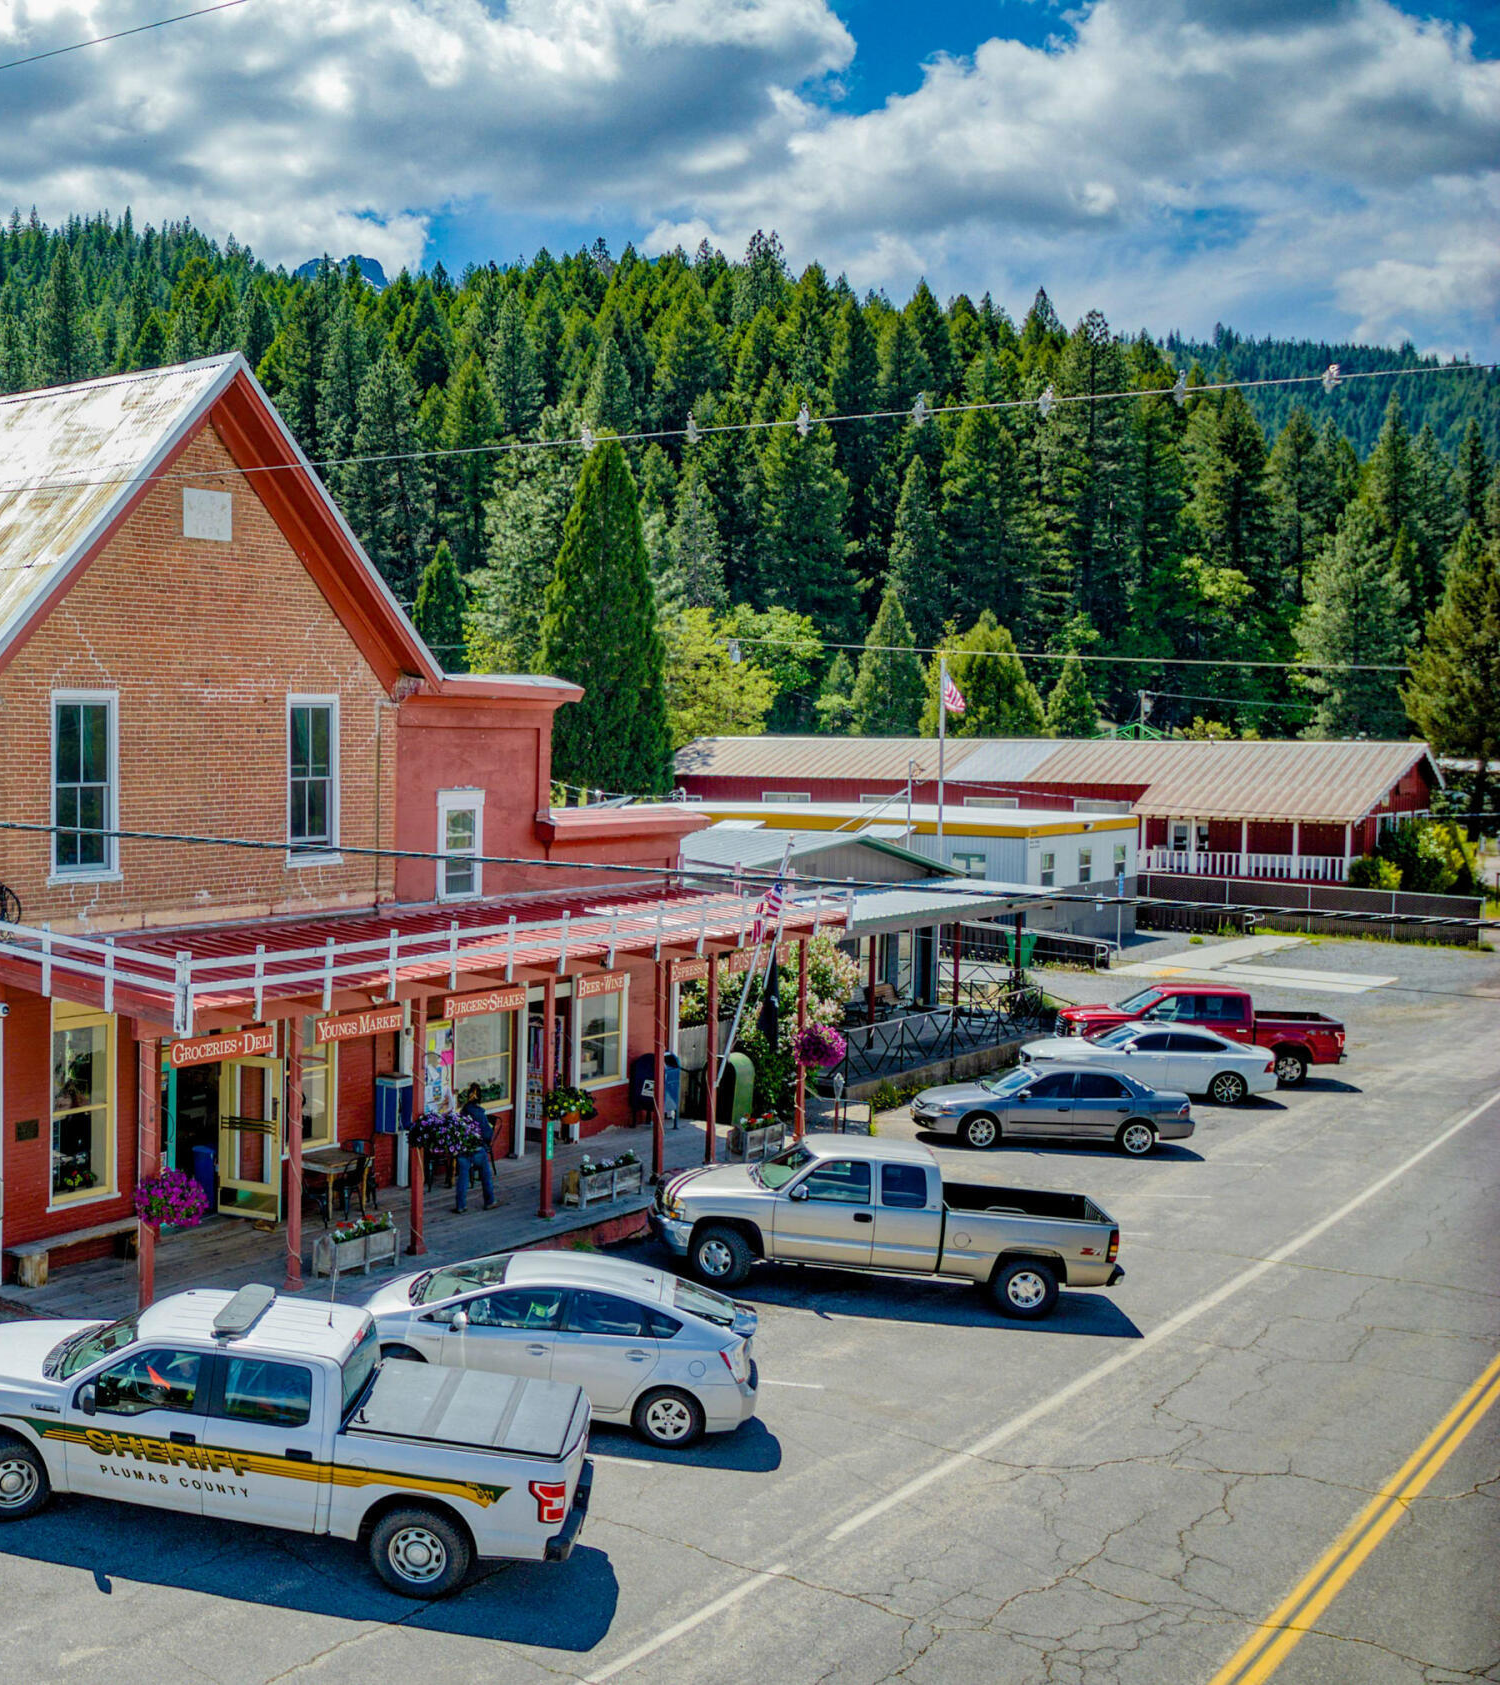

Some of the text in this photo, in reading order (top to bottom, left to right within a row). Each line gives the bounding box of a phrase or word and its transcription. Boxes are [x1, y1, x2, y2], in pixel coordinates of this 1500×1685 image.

[318, 1014, 402, 1041] YOUNGS MARKET
[172, 1033, 273, 1064] GROCERIES DELI
[85, 1429, 251, 1477] SHERIFF
[100, 1464, 250, 1498] PLUMAS COUNTY
[476, 1489, 495, 1500] 911
